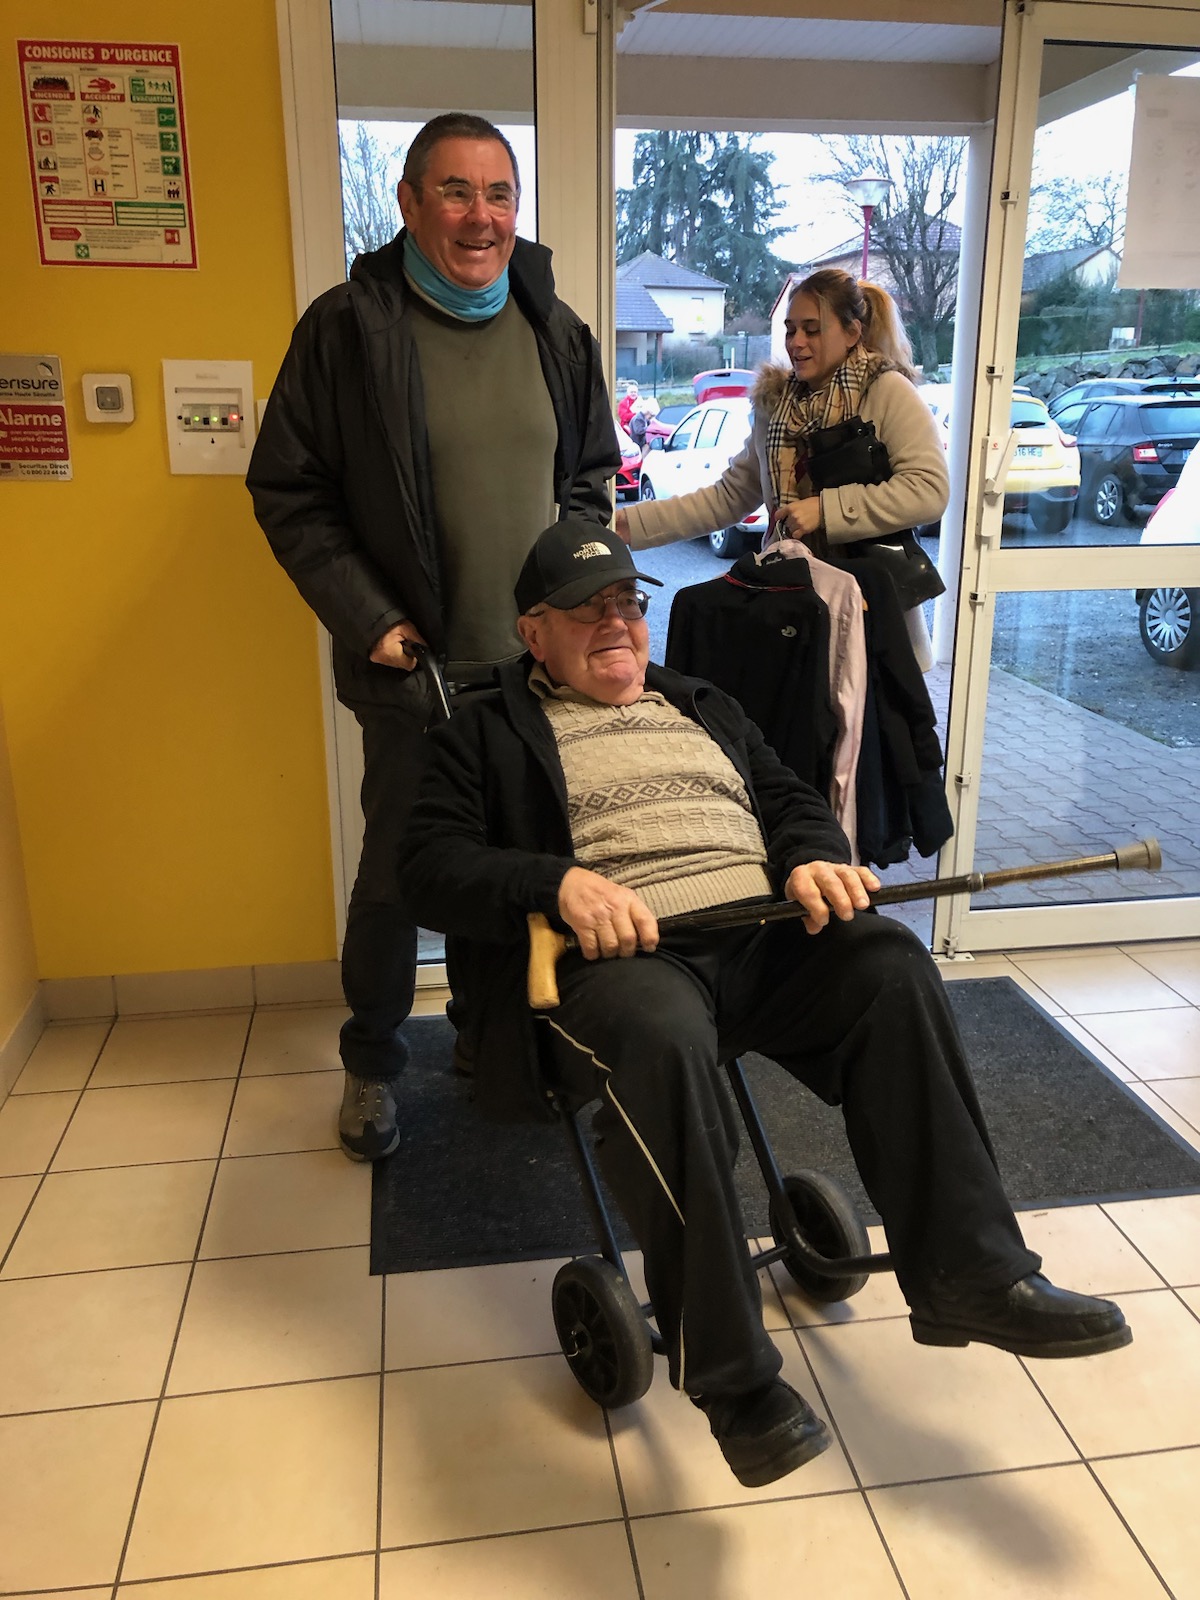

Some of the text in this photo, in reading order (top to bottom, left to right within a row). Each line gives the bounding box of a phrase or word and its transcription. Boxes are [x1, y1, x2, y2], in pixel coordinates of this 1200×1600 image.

[25, 45, 172, 62] CONSIGNES D'URGENCE
[34, 92, 71, 100] INCENDIE
[84, 92, 121, 101] ACCIDENT
[31, 445, 39, 453] la
[41, 445, 65, 455] police
[573, 548, 599, 559] NORTH
